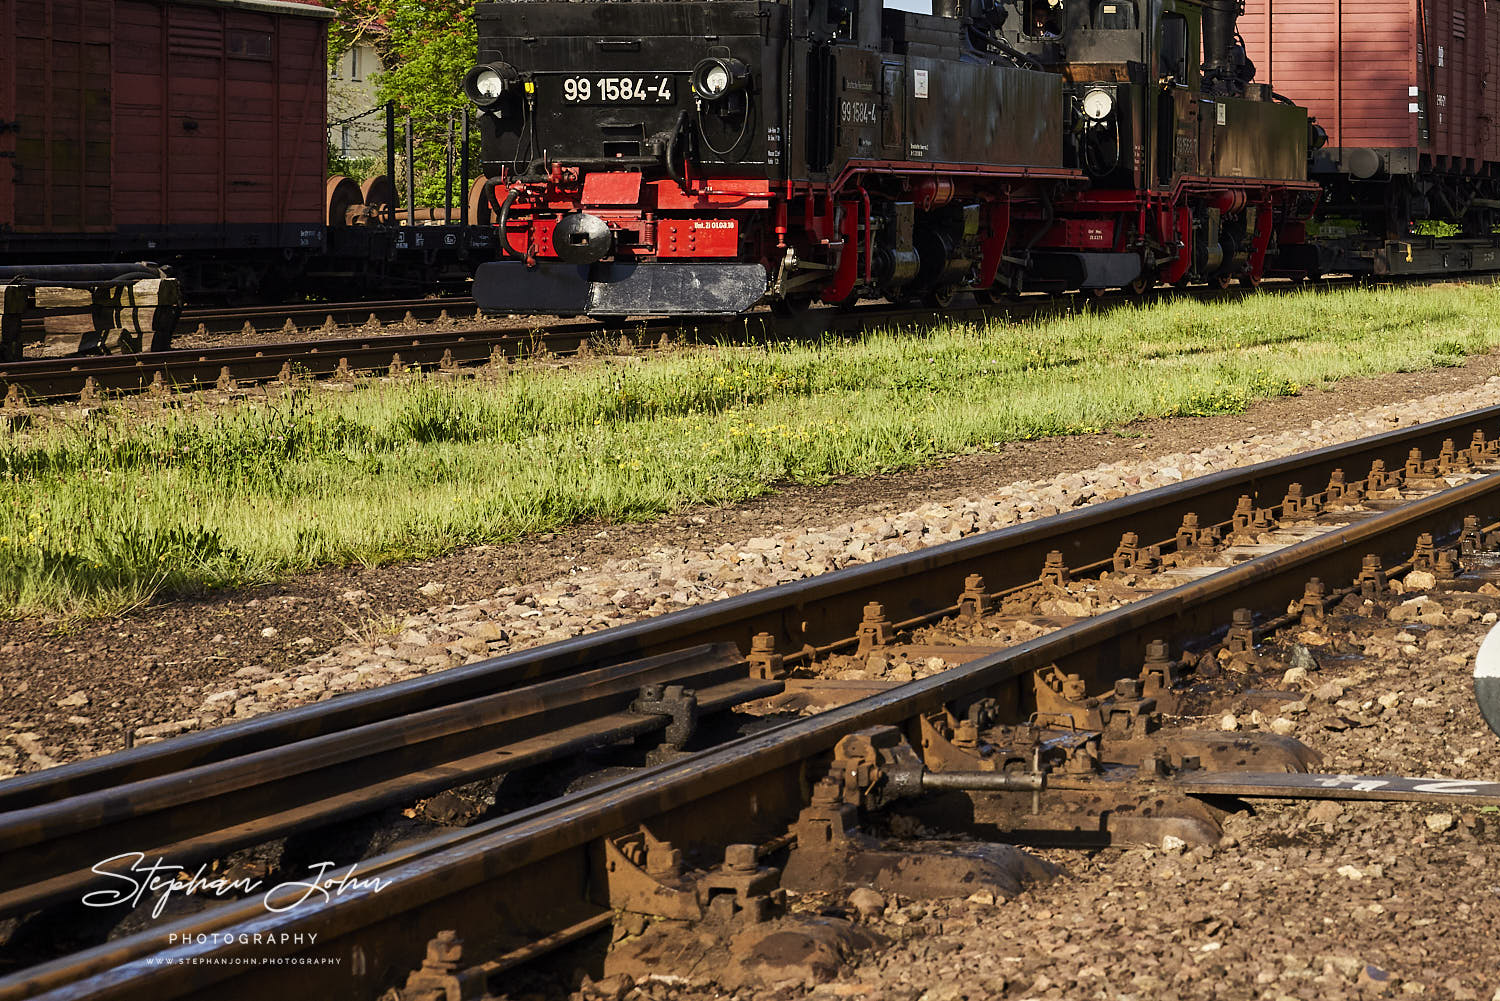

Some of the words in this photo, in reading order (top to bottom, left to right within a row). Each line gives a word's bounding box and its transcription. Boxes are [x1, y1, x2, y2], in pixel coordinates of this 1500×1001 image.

[563, 77, 591, 101] 99
[596, 77, 671, 101] 1584-4
[841, 101, 851, 121] 99
[852, 102, 876, 124] 1584-4
